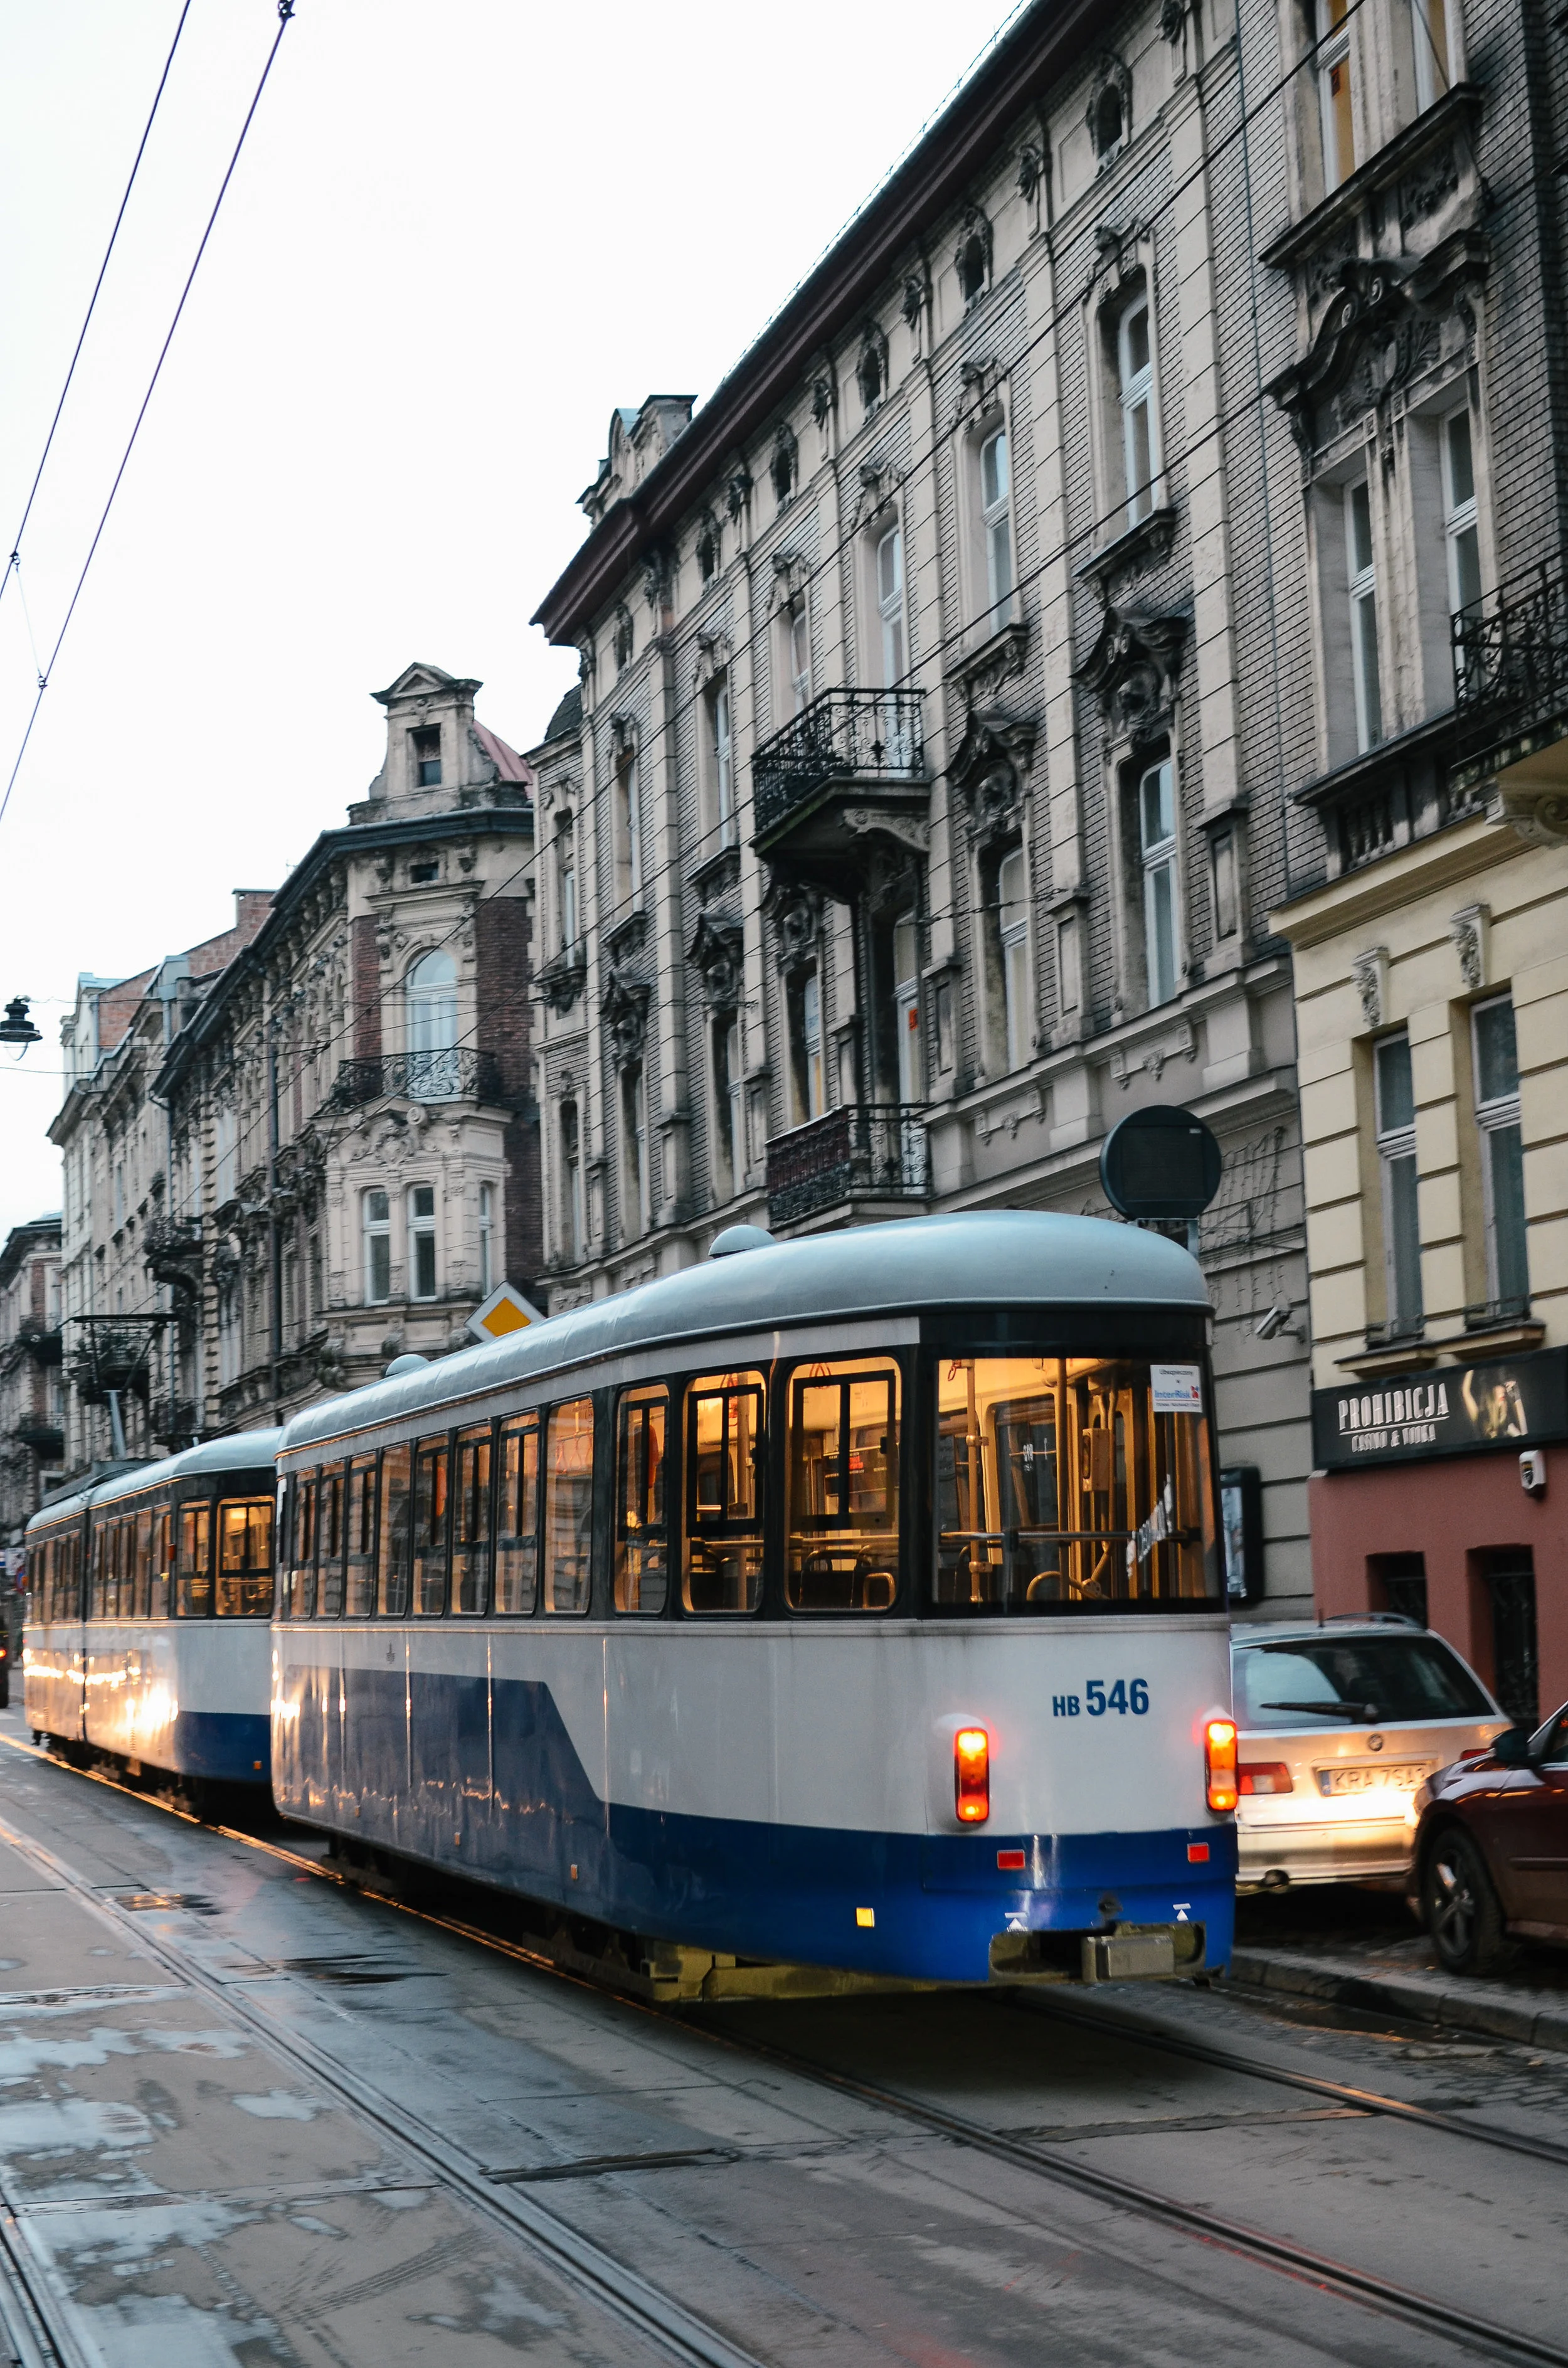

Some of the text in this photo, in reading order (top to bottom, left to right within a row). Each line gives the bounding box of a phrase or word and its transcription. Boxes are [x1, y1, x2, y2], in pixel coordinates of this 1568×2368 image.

[1154, 1389, 1190, 1398] InterRisk
[1338, 1383, 1449, 1430] PROHIBICJA
[1352, 1424, 1436, 1453] CASINO & VODKA
[1052, 1678, 1149, 1716] HB 546
